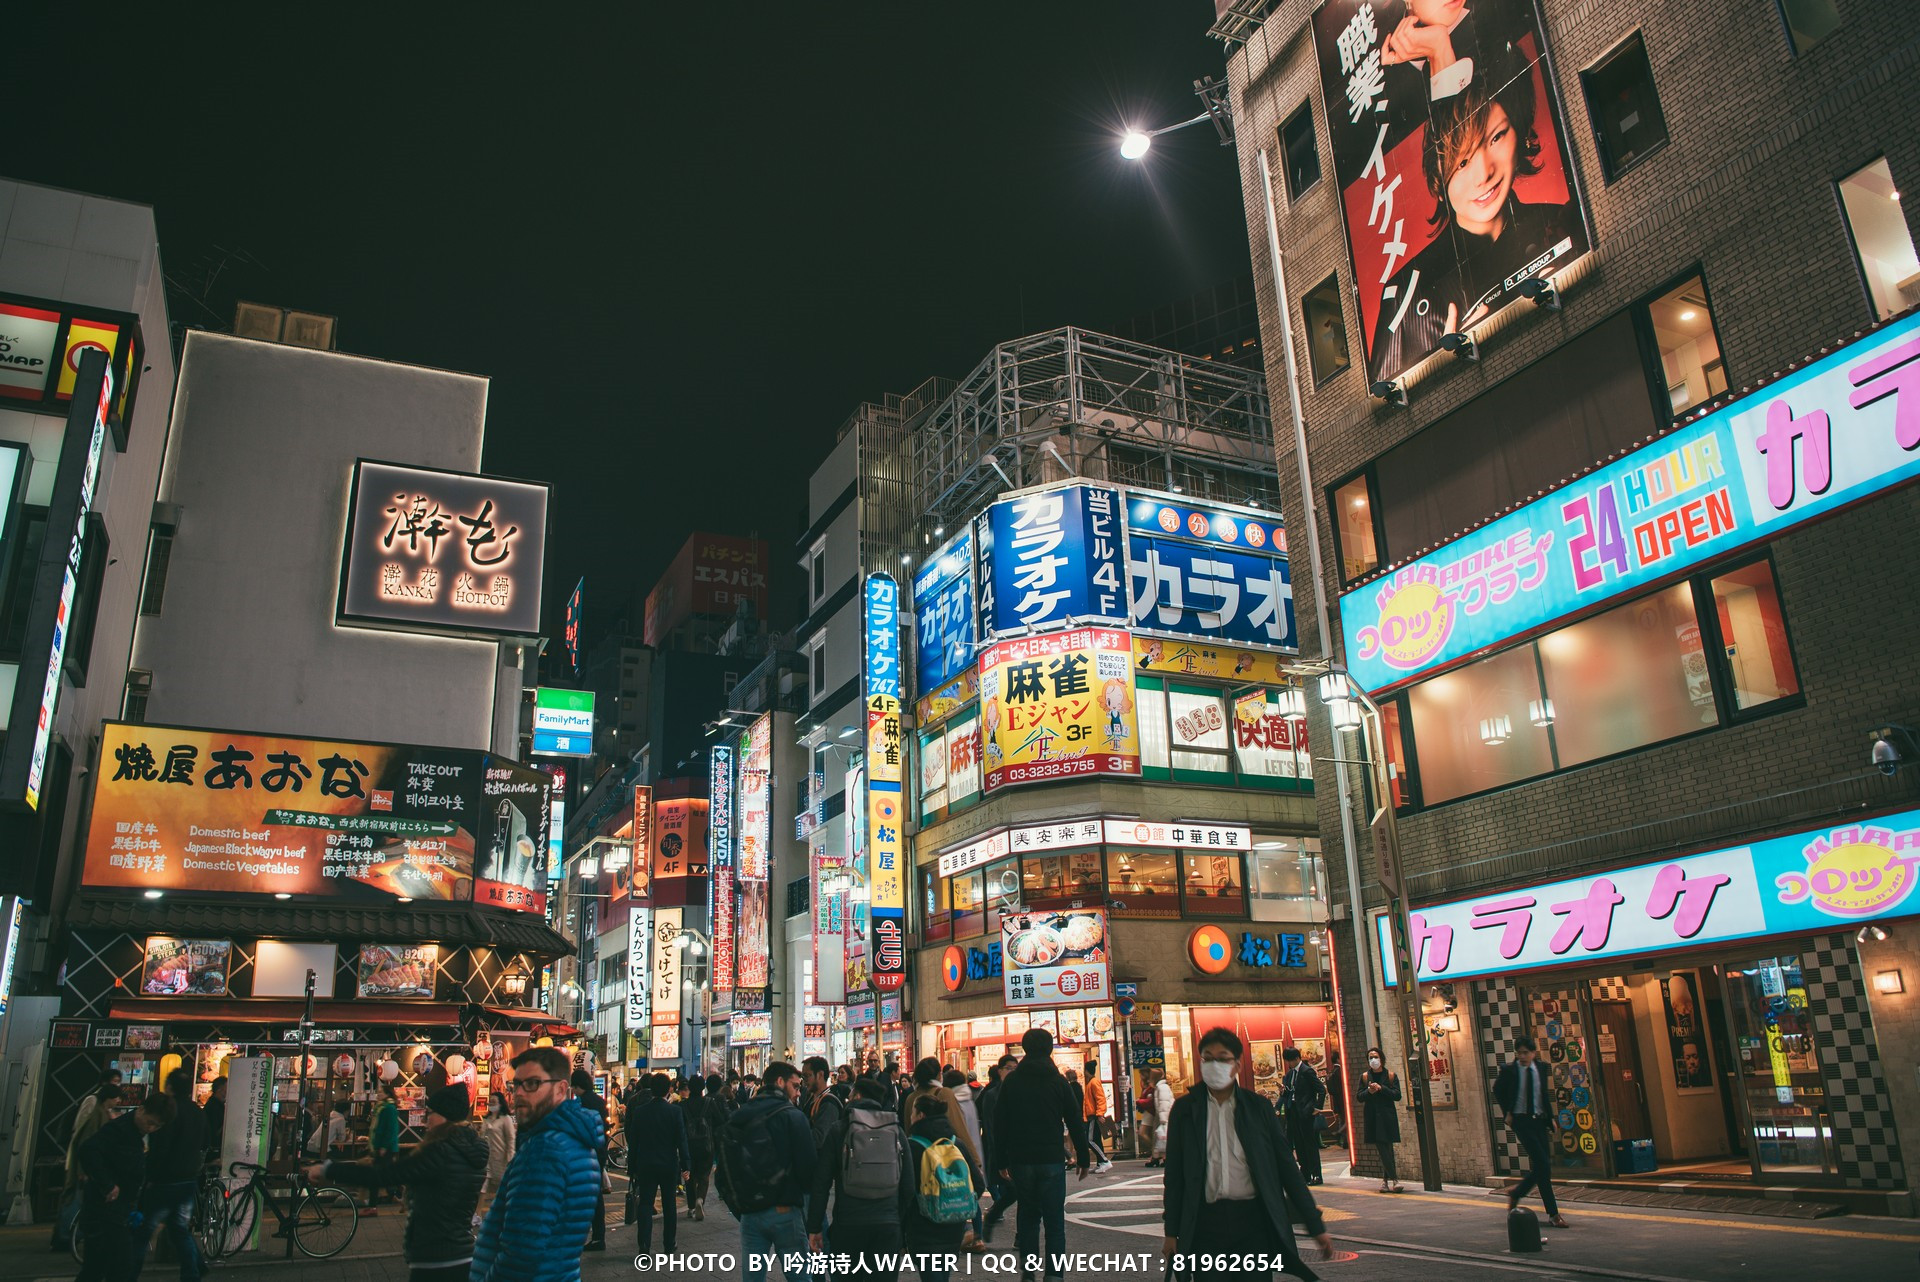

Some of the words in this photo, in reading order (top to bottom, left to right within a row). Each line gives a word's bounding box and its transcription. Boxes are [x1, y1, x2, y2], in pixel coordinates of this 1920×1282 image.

[1337, 3, 1430, 333] 職業、イケメン。
[1516, 268, 1528, 281] AIR
[1528, 254, 1551, 273] GROUP
[1562, 485, 1628, 591] 24
[1622, 433, 1725, 516] HOUR
[1633, 487, 1735, 567] OPEN
[703, 544, 758, 565] パチンコ
[1010, 495, 1072, 625] カラオケ
[1089, 489, 1120, 615] 当ビル4F
[694, 565, 767, 589] エスパス
[1376, 528, 1531, 612] KARAOKE
[384, 583, 435, 600] KANKA
[456, 591, 508, 606] HOTPOT
[921, 577, 973, 648] カラオ
[870, 580, 895, 675] カラオケ
[870, 677, 896, 693] 747
[1005, 653, 1090, 705] 麻雀
[872, 695, 896, 712] 4F
[539, 713, 590, 726] FamilyMart
[1006, 700, 1091, 732] Eジャン
[556, 737, 571, 750] 酒
[884, 717, 900, 765] 麻雀
[1066, 724, 1092, 741] 3F
[111, 743, 367, 799] 焼屋あおな
[1009, 759, 1096, 780] 03-3232-5755
[1107, 757, 1133, 771] 3F
[1264, 758, 1295, 778] LET'S
[989, 772, 1003, 788] 3F
[406, 794, 464, 811] 테이크아웃
[714, 761, 729, 827] ホテルがライバル
[115, 821, 159, 835] 国産牛
[295, 813, 331, 828] あおな
[339, 817, 430, 833] 西武新宿駅前はこちら
[659, 813, 687, 823] ダイニング
[189, 824, 241, 840] Domestic
[242, 828, 271, 842] beef
[326, 834, 373, 849] 国产牛肉
[637, 795, 647, 866] 個室ダイニング居酒屋
[1120, 824, 1165, 843] 一番館
[1171, 828, 1238, 846] 中華食堂
[111, 836, 162, 853] 黒毛和牛
[183, 842, 225, 857] Japanese
[225, 843, 252, 857] Black
[251, 845, 283, 860] Wagyu
[283, 846, 307, 860] beef
[716, 827, 728, 860] DVD
[876, 824, 896, 870] 松屋
[109, 852, 167, 874] 国産野菜
[183, 858, 236, 873] Domestic
[236, 861, 300, 877] Vegetables
[663, 861, 680, 873] 4F
[1411, 864, 1731, 973] カラオケ
[632, 913, 645, 961] とんかつ
[875, 919, 902, 971] HUB
[148, 943, 174, 955] SIRLOIN
[156, 949, 177, 960] STEAK
[1083, 954, 1095, 963] 2F
[1238, 931, 1307, 968] 松屋
[658, 945, 674, 1001] てけてけ
[878, 975, 899, 986] B1F
[1010, 974, 1034, 986] 中華
[1040, 971, 1100, 993] 一番館
[630, 965, 645, 1021] にいむら
[1011, 986, 1035, 1000] 食堂
[259, 1060, 271, 1089] Clean
[254, 1091, 269, 1136] Shinjuku
